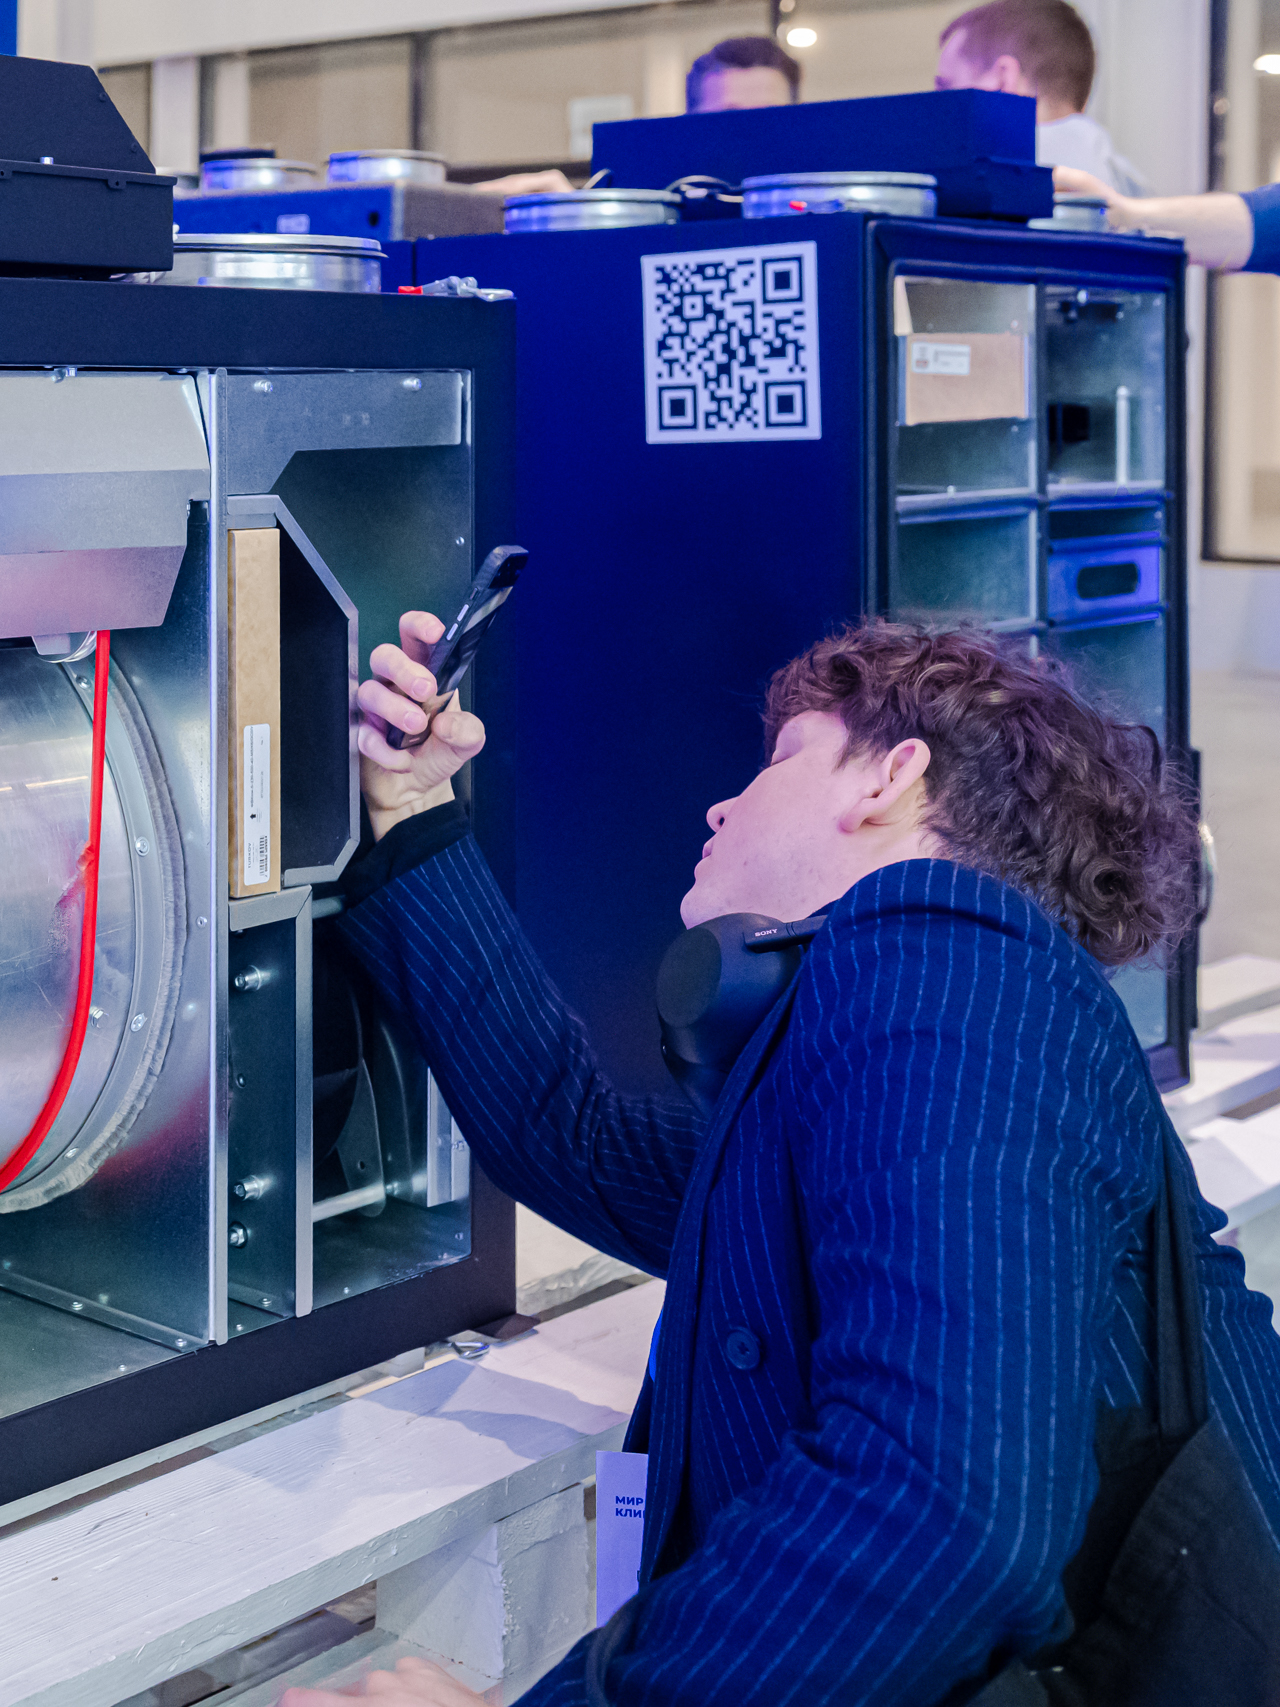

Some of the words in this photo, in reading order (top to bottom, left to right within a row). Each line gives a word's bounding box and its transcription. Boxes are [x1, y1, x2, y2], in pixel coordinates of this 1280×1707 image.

[754, 928, 778, 937] SONY
[615, 1495, 644, 1506] МИР
[615, 1508, 645, 1519] КЛИ
